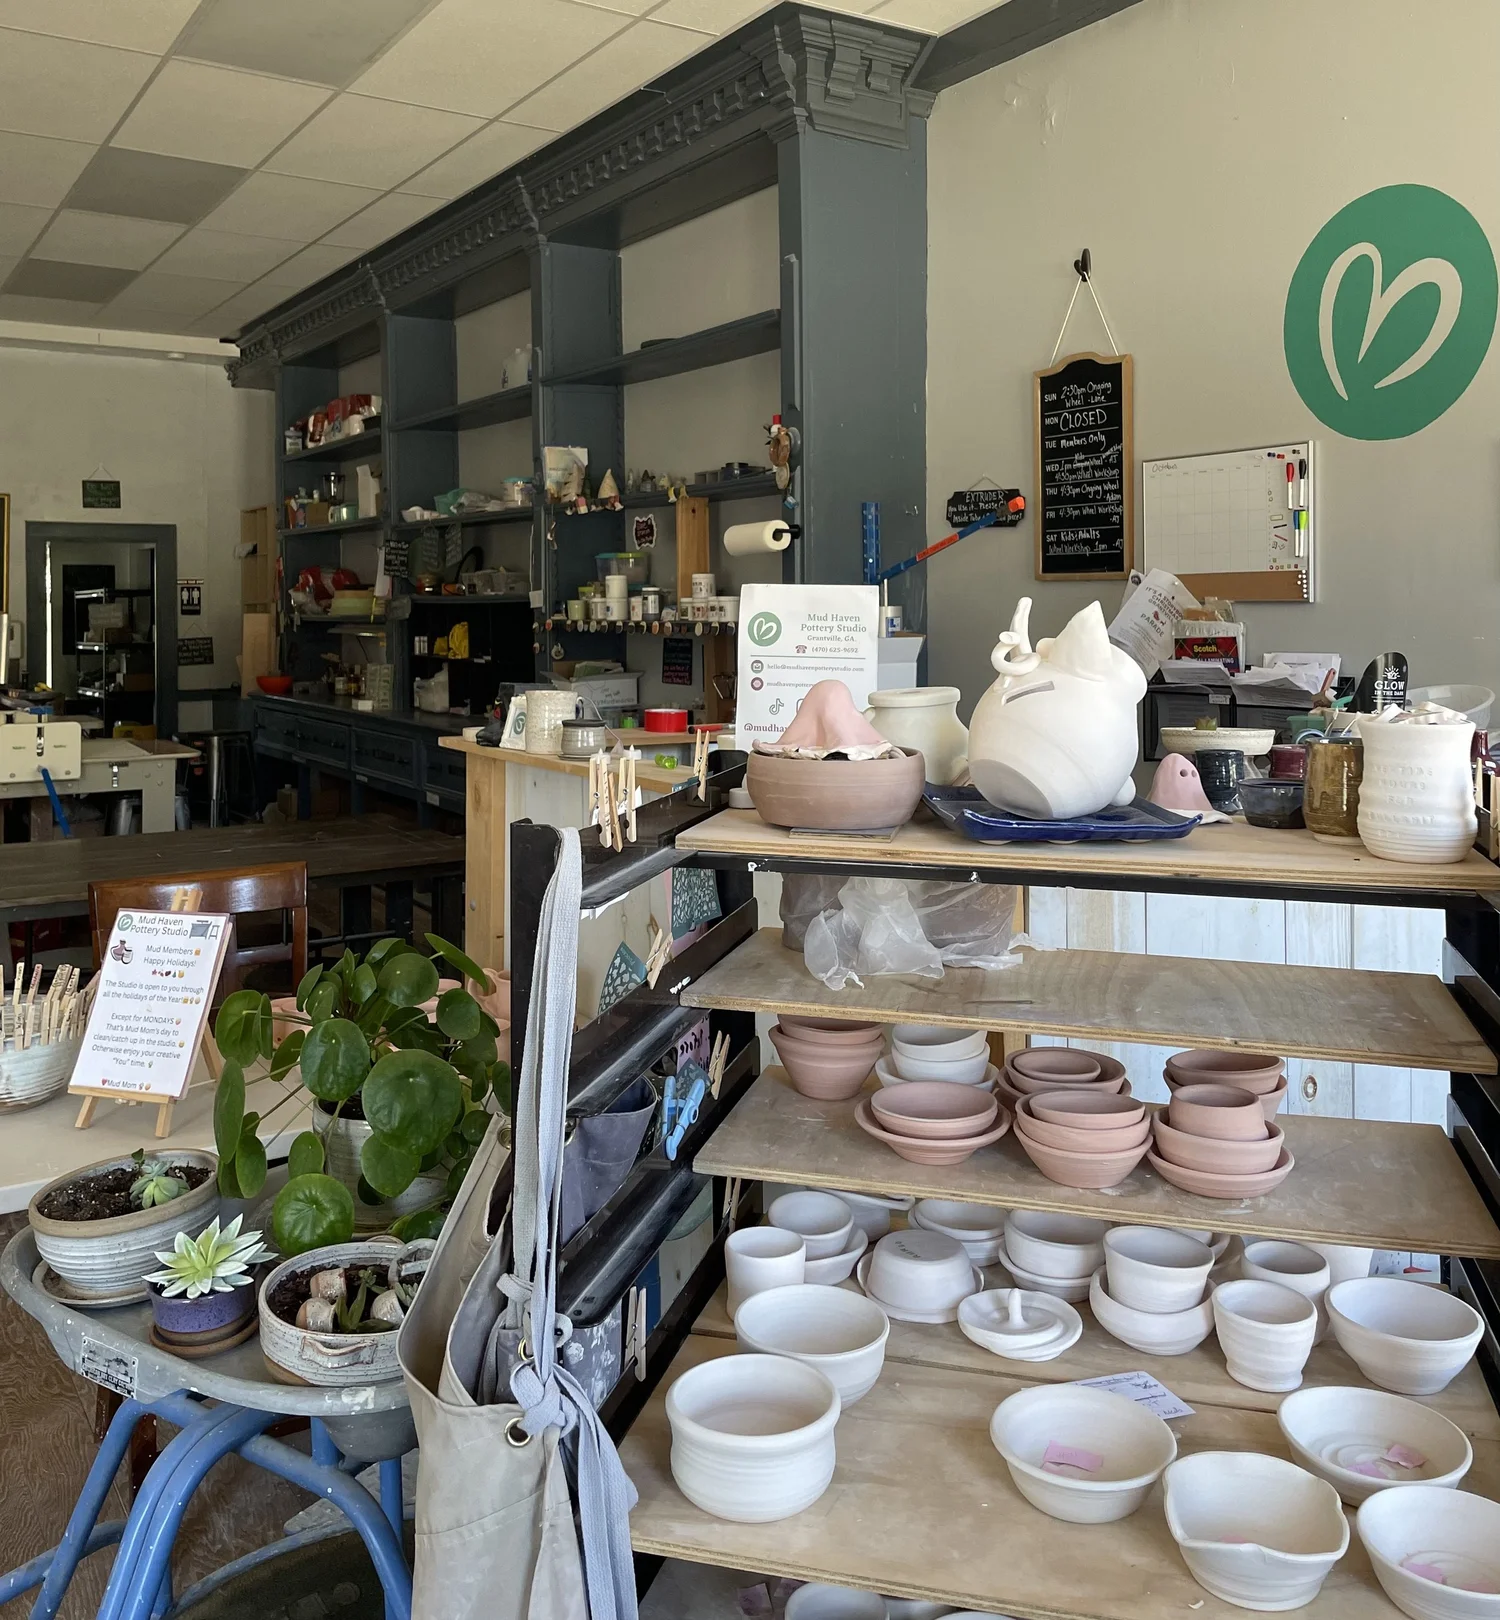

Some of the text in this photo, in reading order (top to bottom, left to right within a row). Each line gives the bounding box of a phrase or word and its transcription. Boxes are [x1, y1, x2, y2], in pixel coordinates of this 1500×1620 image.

[1044, 381, 1112, 402] SUN 2:30pm Ongoing
[1065, 395, 1084, 408] Wheel
[1045, 409, 1107, 431] MON CLOSED
[1045, 440, 1057, 449] TUE
[1088, 431, 1106, 451] Only
[1045, 464, 1059, 472] WED
[1045, 488, 1058, 496] THU
[1081, 484, 1102, 499] Ongoing
[1102, 479, 1119, 491] Wheel
[965, 490, 1005, 503] EXTRUDER
[1046, 511, 1056, 519] FRI
[1081, 505, 1097, 515] Wheel
[1046, 534, 1057, 542] SAT
[807, 613, 860, 622] Mud Haven
[800, 623, 867, 633] Pottery Studio
[1140, 613, 1165, 637] PARADE
[1193, 645, 1217, 653] Scotch
[1374, 680, 1405, 690] GLOW
[138, 916, 184, 926] Mud Haven
[130, 924, 189, 936] Pottery Studio
[146, 945, 194, 956] Mud Members
[143, 956, 197, 967] Happy Holidays!
[105, 979, 117, 987] The
[117, 980, 138, 989] Studio
[181, 985, 204, 995] through
[111, 991, 122, 999] the
[122, 992, 148, 1001] holidays
[156, 994, 167, 1002] the
[111, 1012, 175, 1024] Except for MONDAYS
[105, 1023, 124, 1031] That's
[140, 1026, 160, 1035] Mom's
[160, 1028, 171, 1037] day
[129, 1037, 138, 1045] up
[146, 1038, 157, 1046] the
[92, 1044, 181, 1059] Otherwise enjoy your creative
[107, 1079, 137, 1089] Mud Mom
